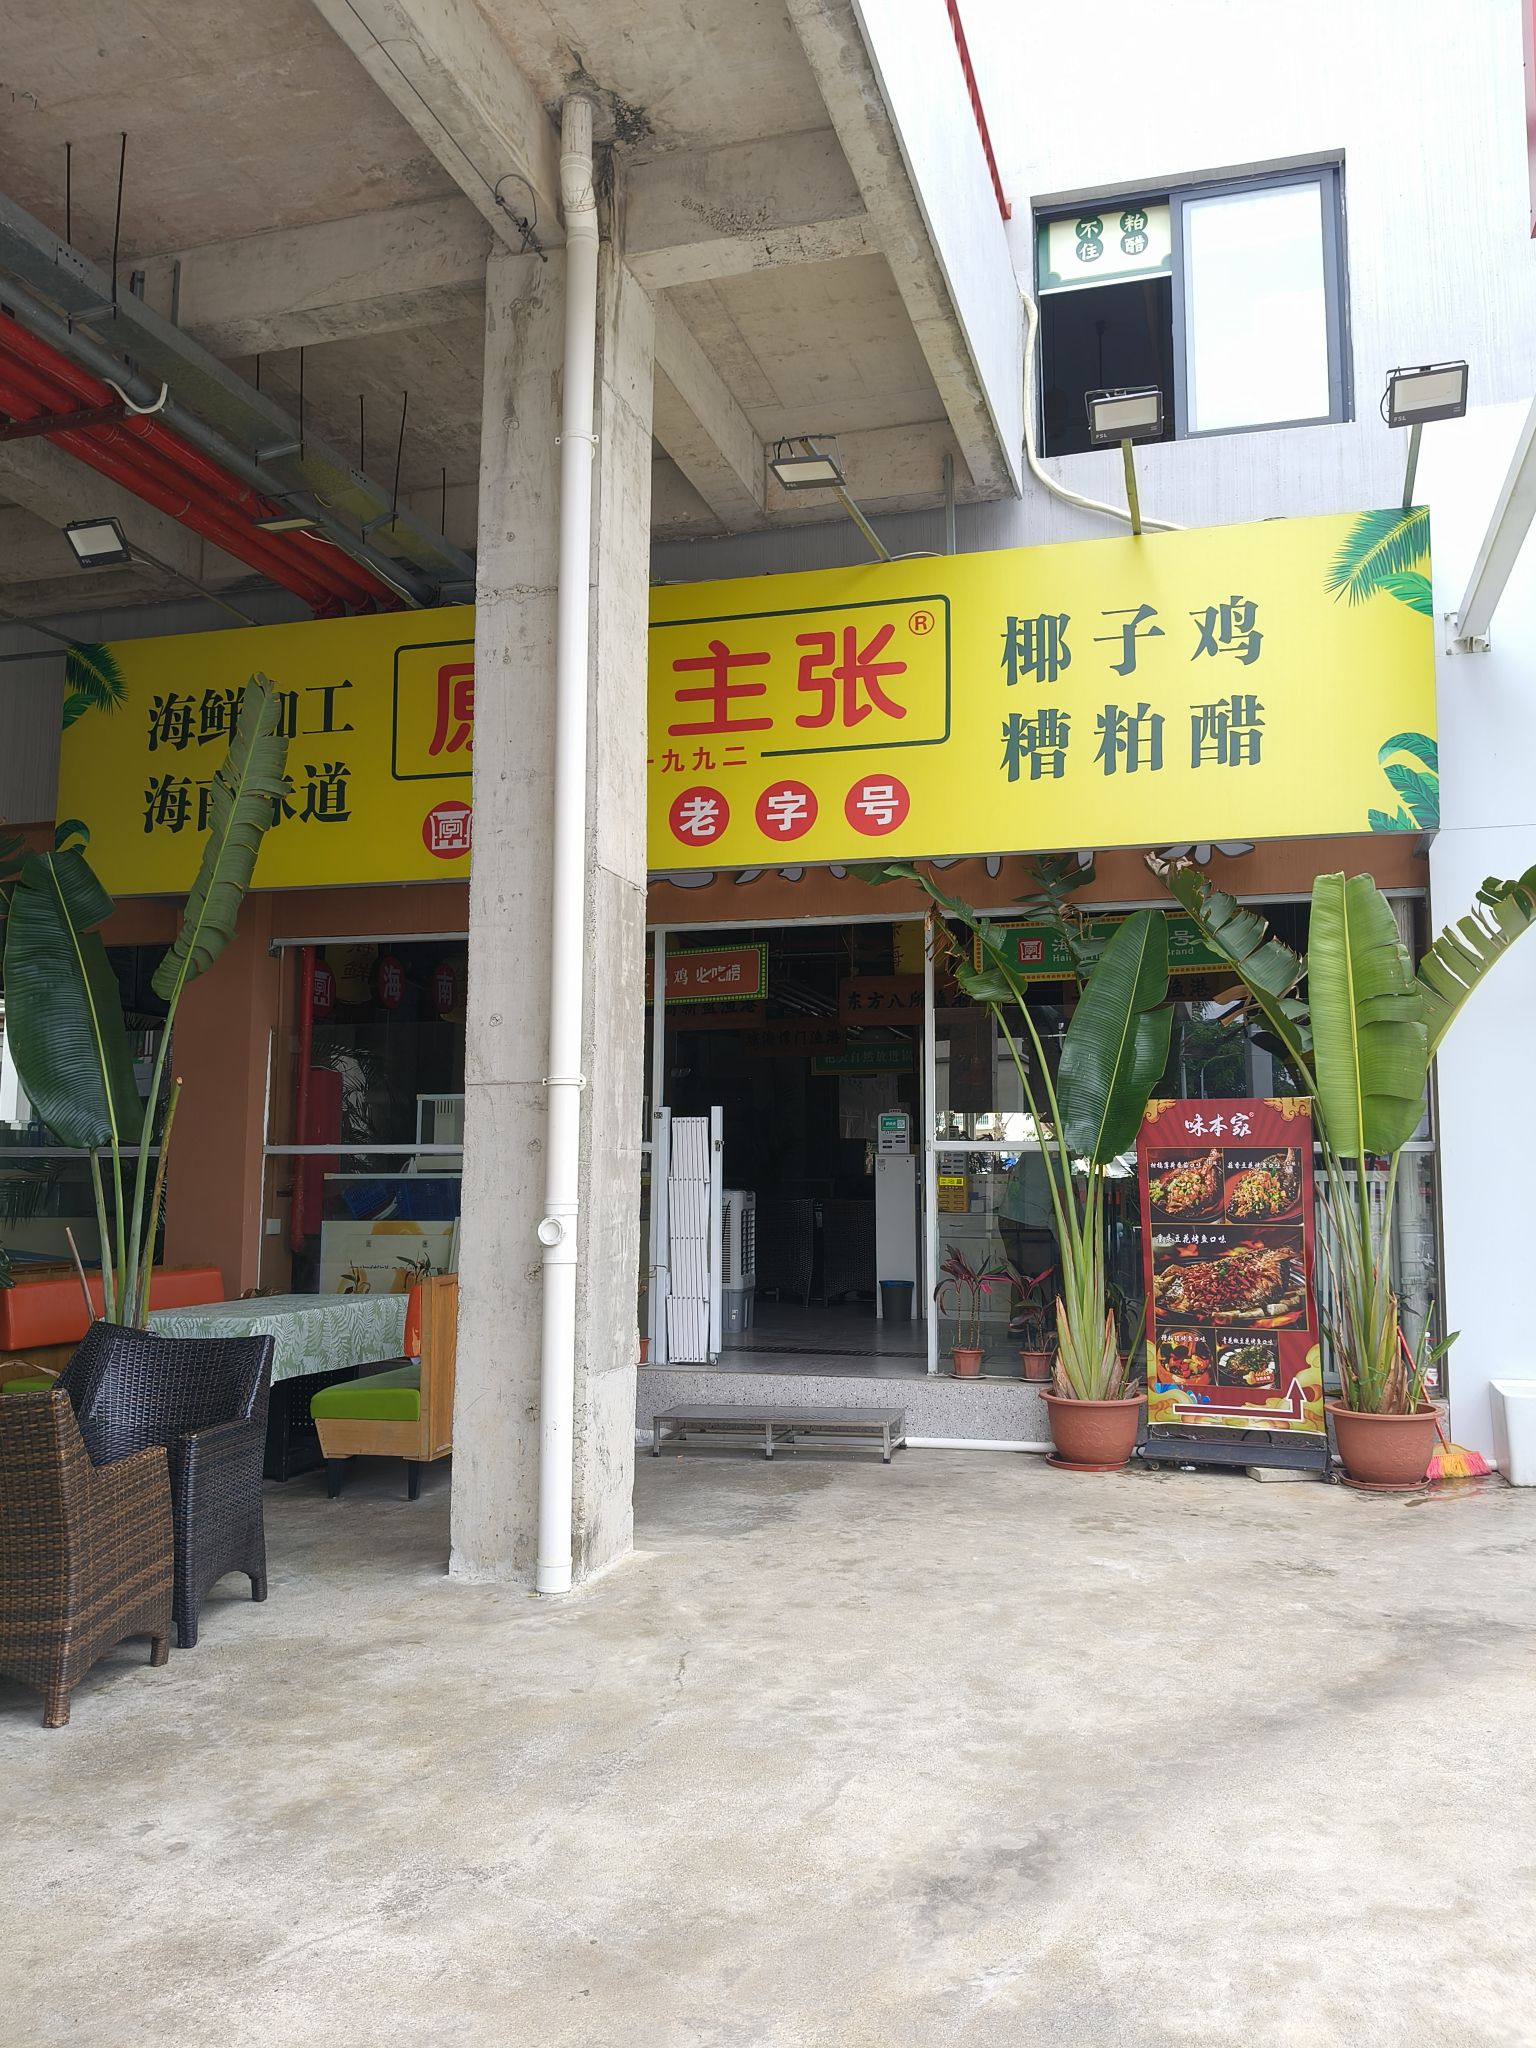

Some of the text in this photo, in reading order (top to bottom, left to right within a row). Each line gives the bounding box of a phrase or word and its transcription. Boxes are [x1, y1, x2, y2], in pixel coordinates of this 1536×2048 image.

[1000, 595, 1265, 687] 椰子鸡
[1000, 694, 1266, 783] 糟粕醋
[679, 784, 900, 837] 老字号
[1184, 1113, 1252, 1138] 味本家
